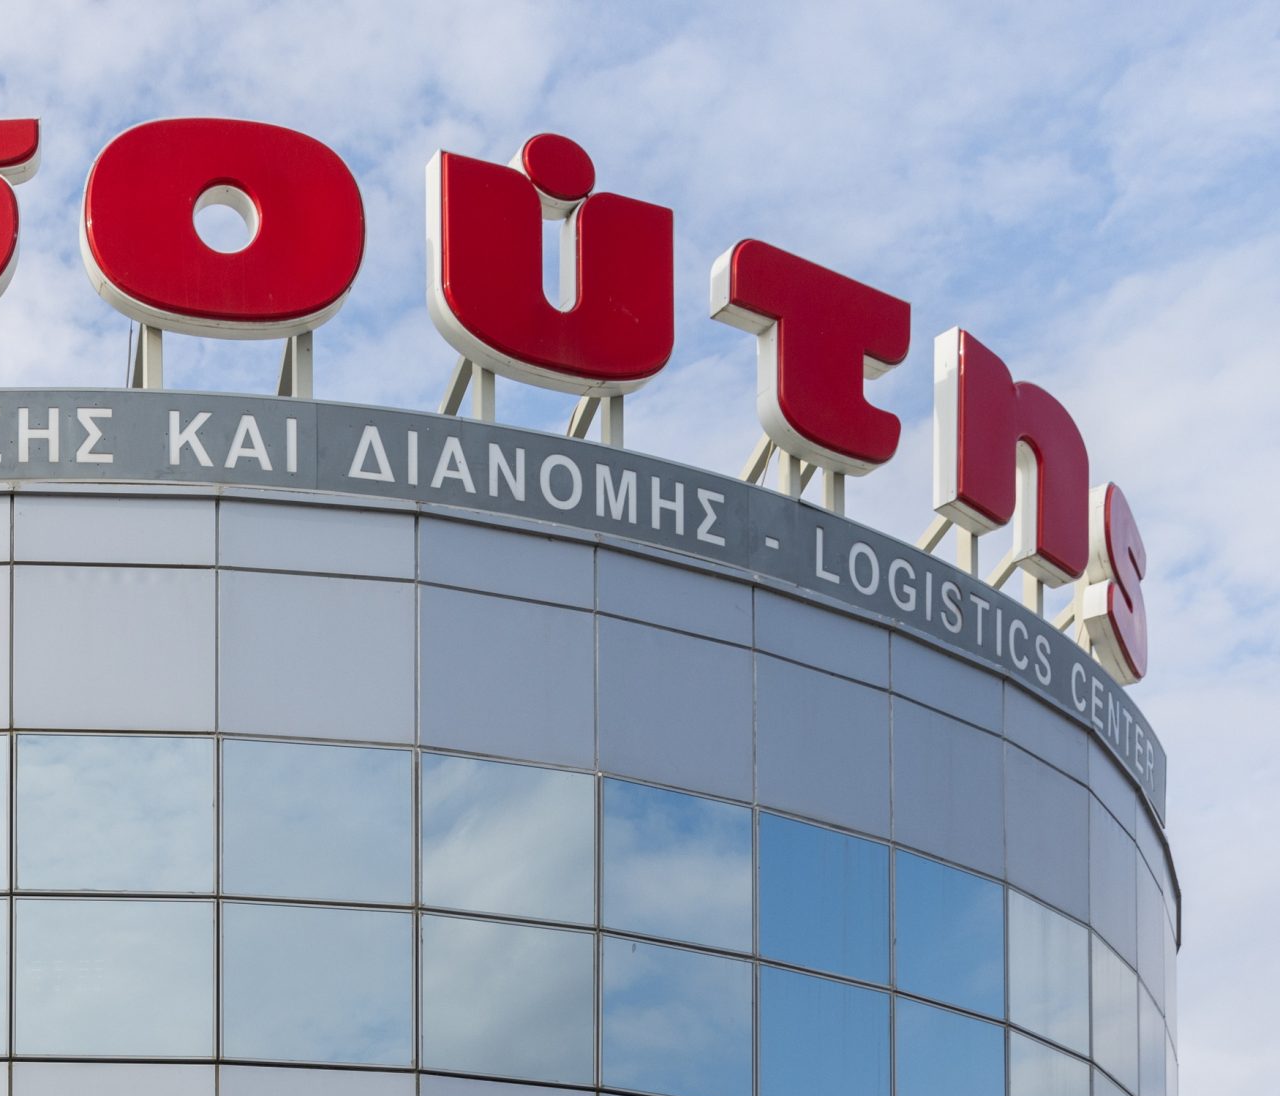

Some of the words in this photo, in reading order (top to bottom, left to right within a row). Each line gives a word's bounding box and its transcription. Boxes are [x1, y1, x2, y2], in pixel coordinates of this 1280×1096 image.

[169, 410, 297, 473] ΚΑΙ
[348, 425, 726, 547] ΔΙΑΝΟΜΗΣ
[765, 536, 780, 549] -
[815, 527, 1052, 686] LOGISTICS
[1071, 662, 1154, 790] CENTER
